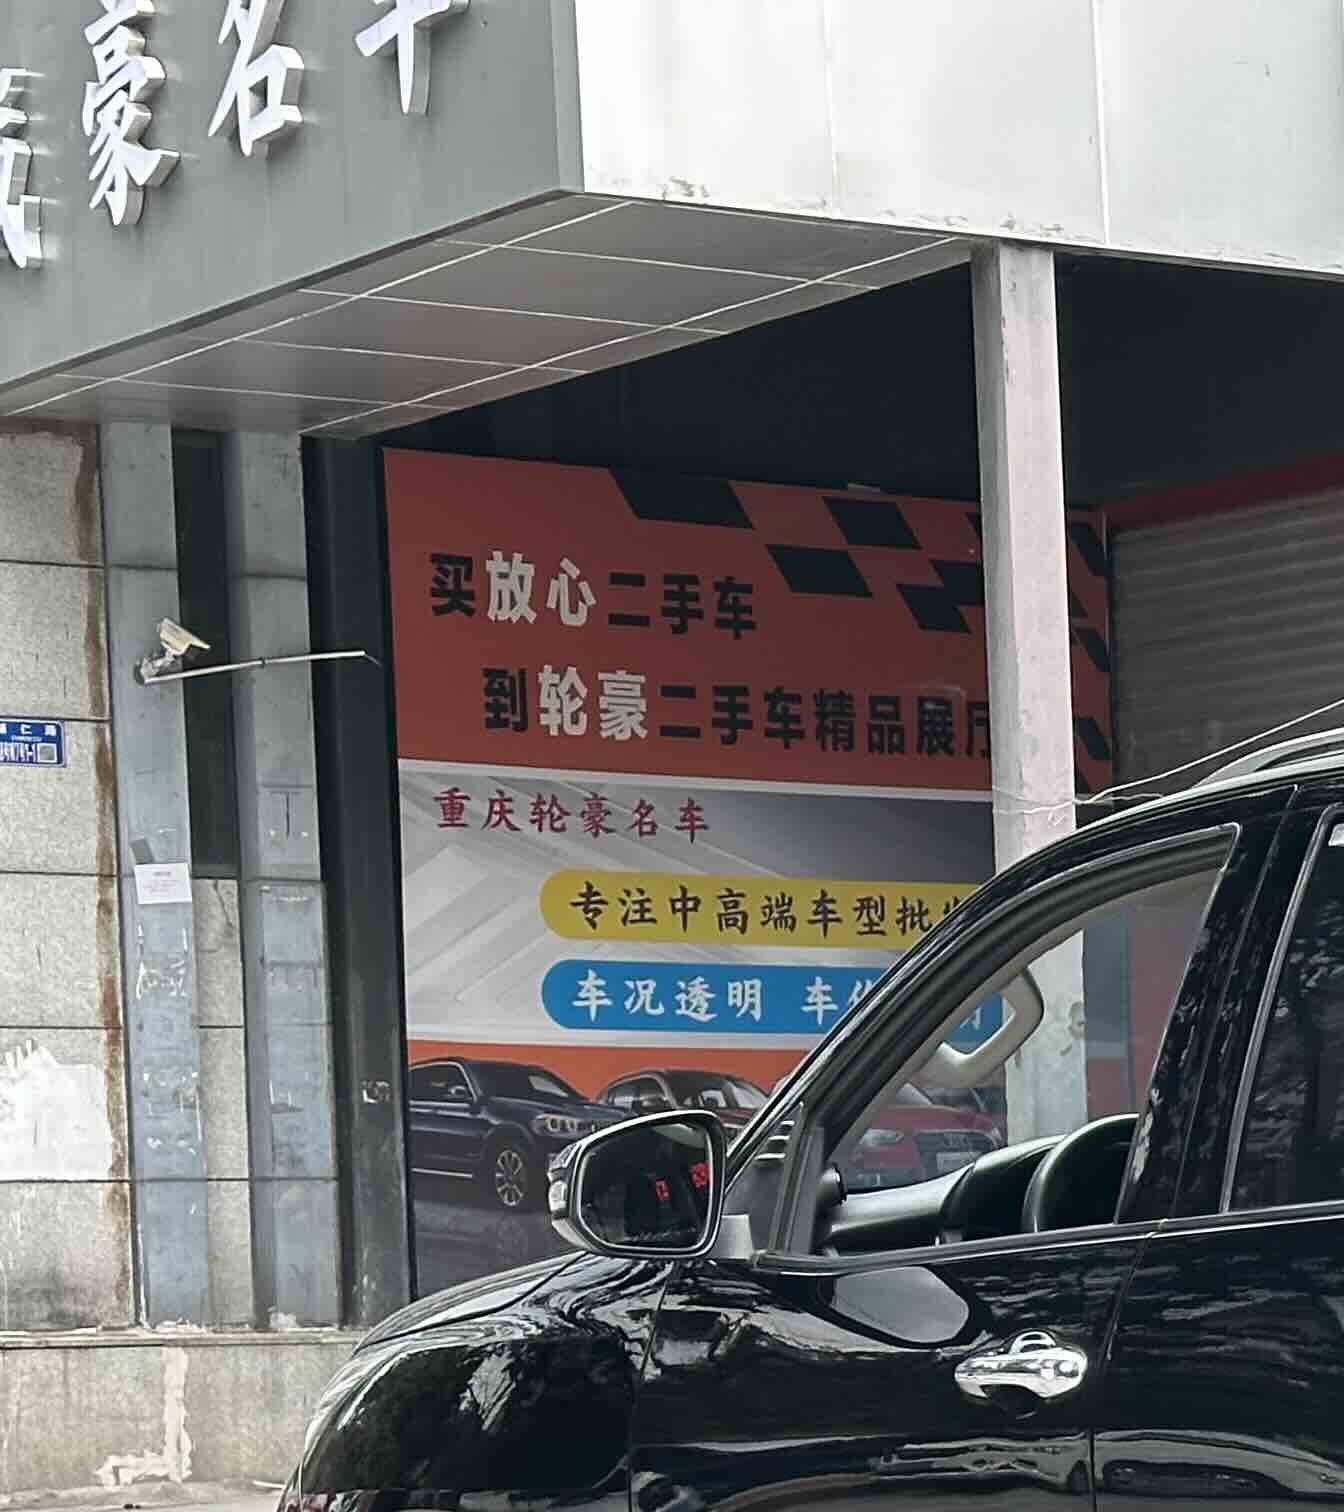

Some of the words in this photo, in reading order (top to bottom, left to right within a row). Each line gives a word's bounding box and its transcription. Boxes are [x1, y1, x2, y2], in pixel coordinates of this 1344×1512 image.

[430, 551, 757, 640] 买放心二手车
[433, 787, 711, 843] 重庆轮豪名车
[569, 882, 960, 938] 专注中高端车型批
[571, 969, 765, 1024] 车况透明
